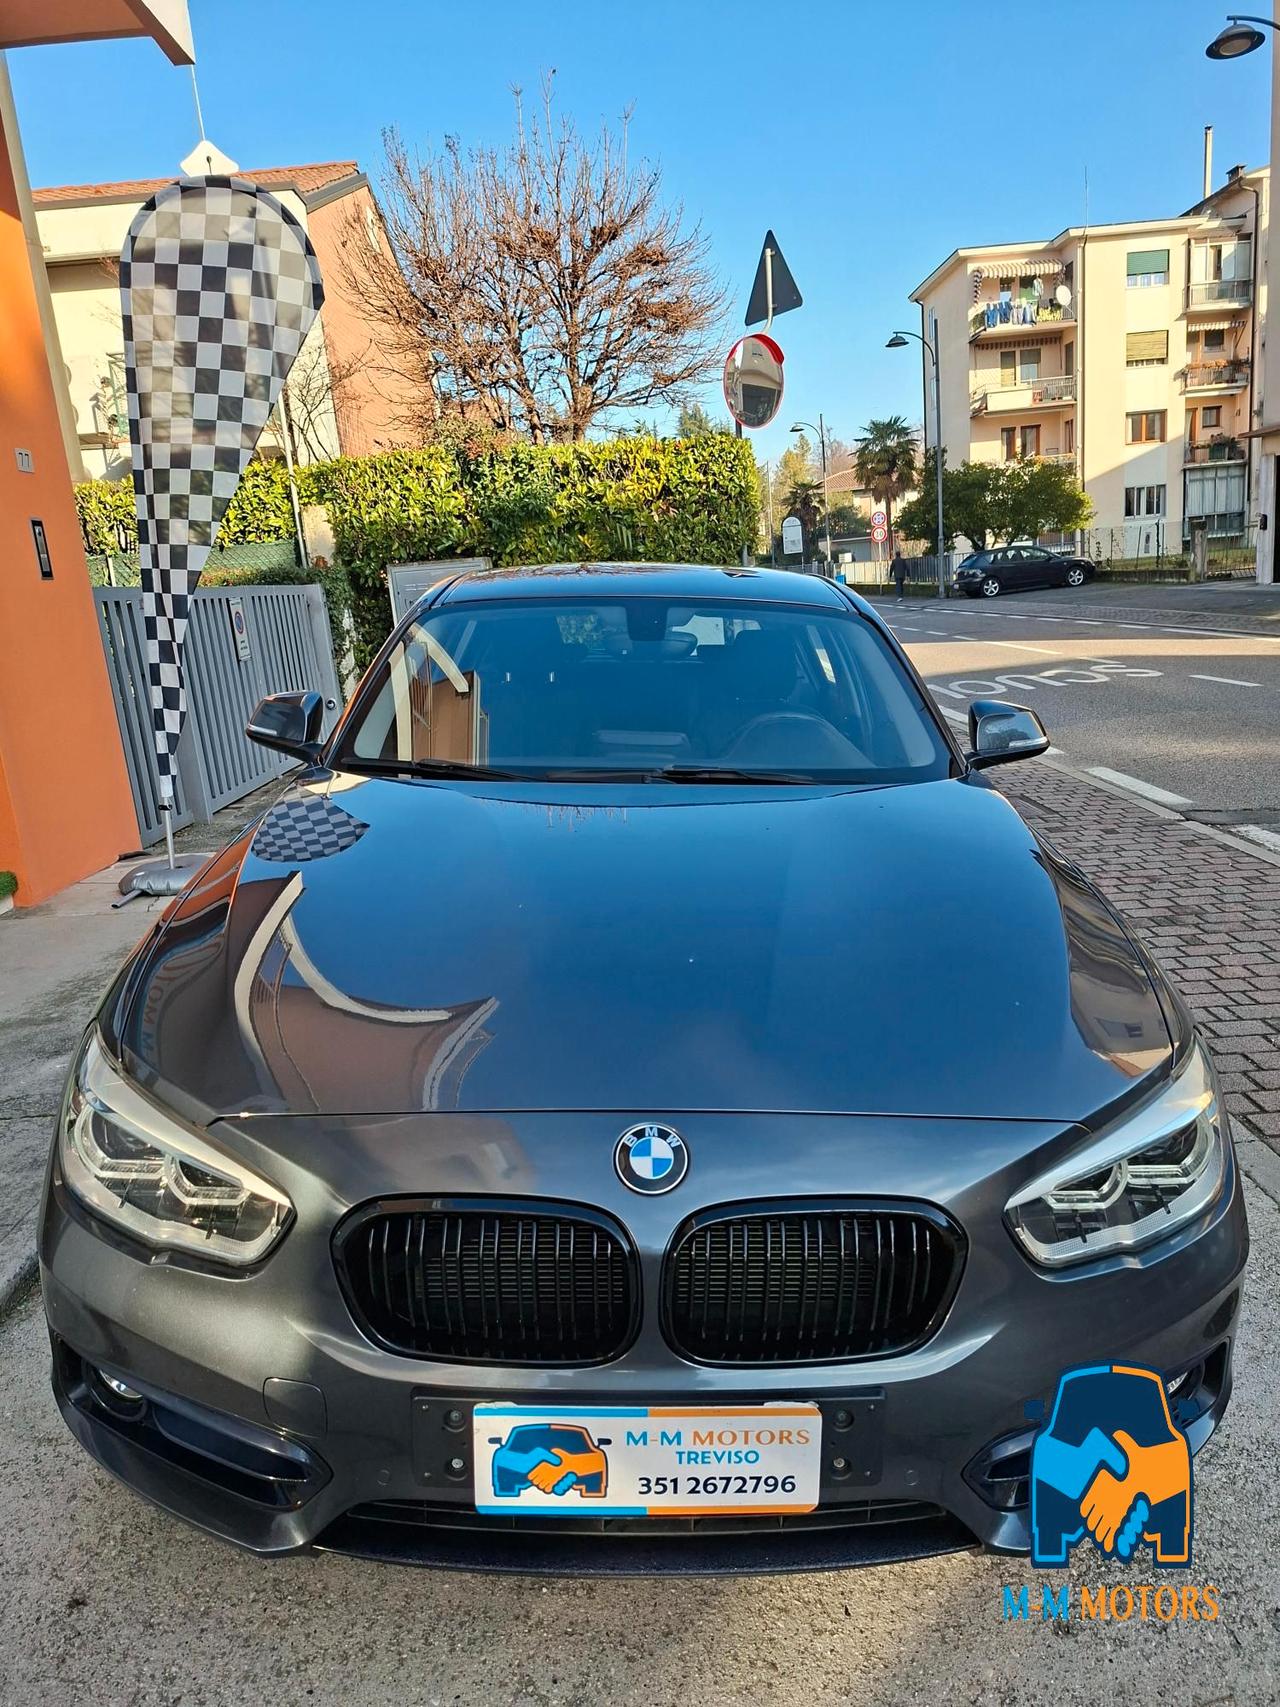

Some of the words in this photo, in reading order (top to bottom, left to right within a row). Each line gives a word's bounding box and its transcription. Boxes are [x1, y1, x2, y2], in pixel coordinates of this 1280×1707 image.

[623, 1126, 681, 1148] BMW
[625, 1430, 682, 1447] M-M
[692, 1429, 811, 1446] MOTORS
[676, 1450, 760, 1465] TREVISO
[638, 1476, 679, 1495] 351
[687, 1475, 797, 1495] 2672796
